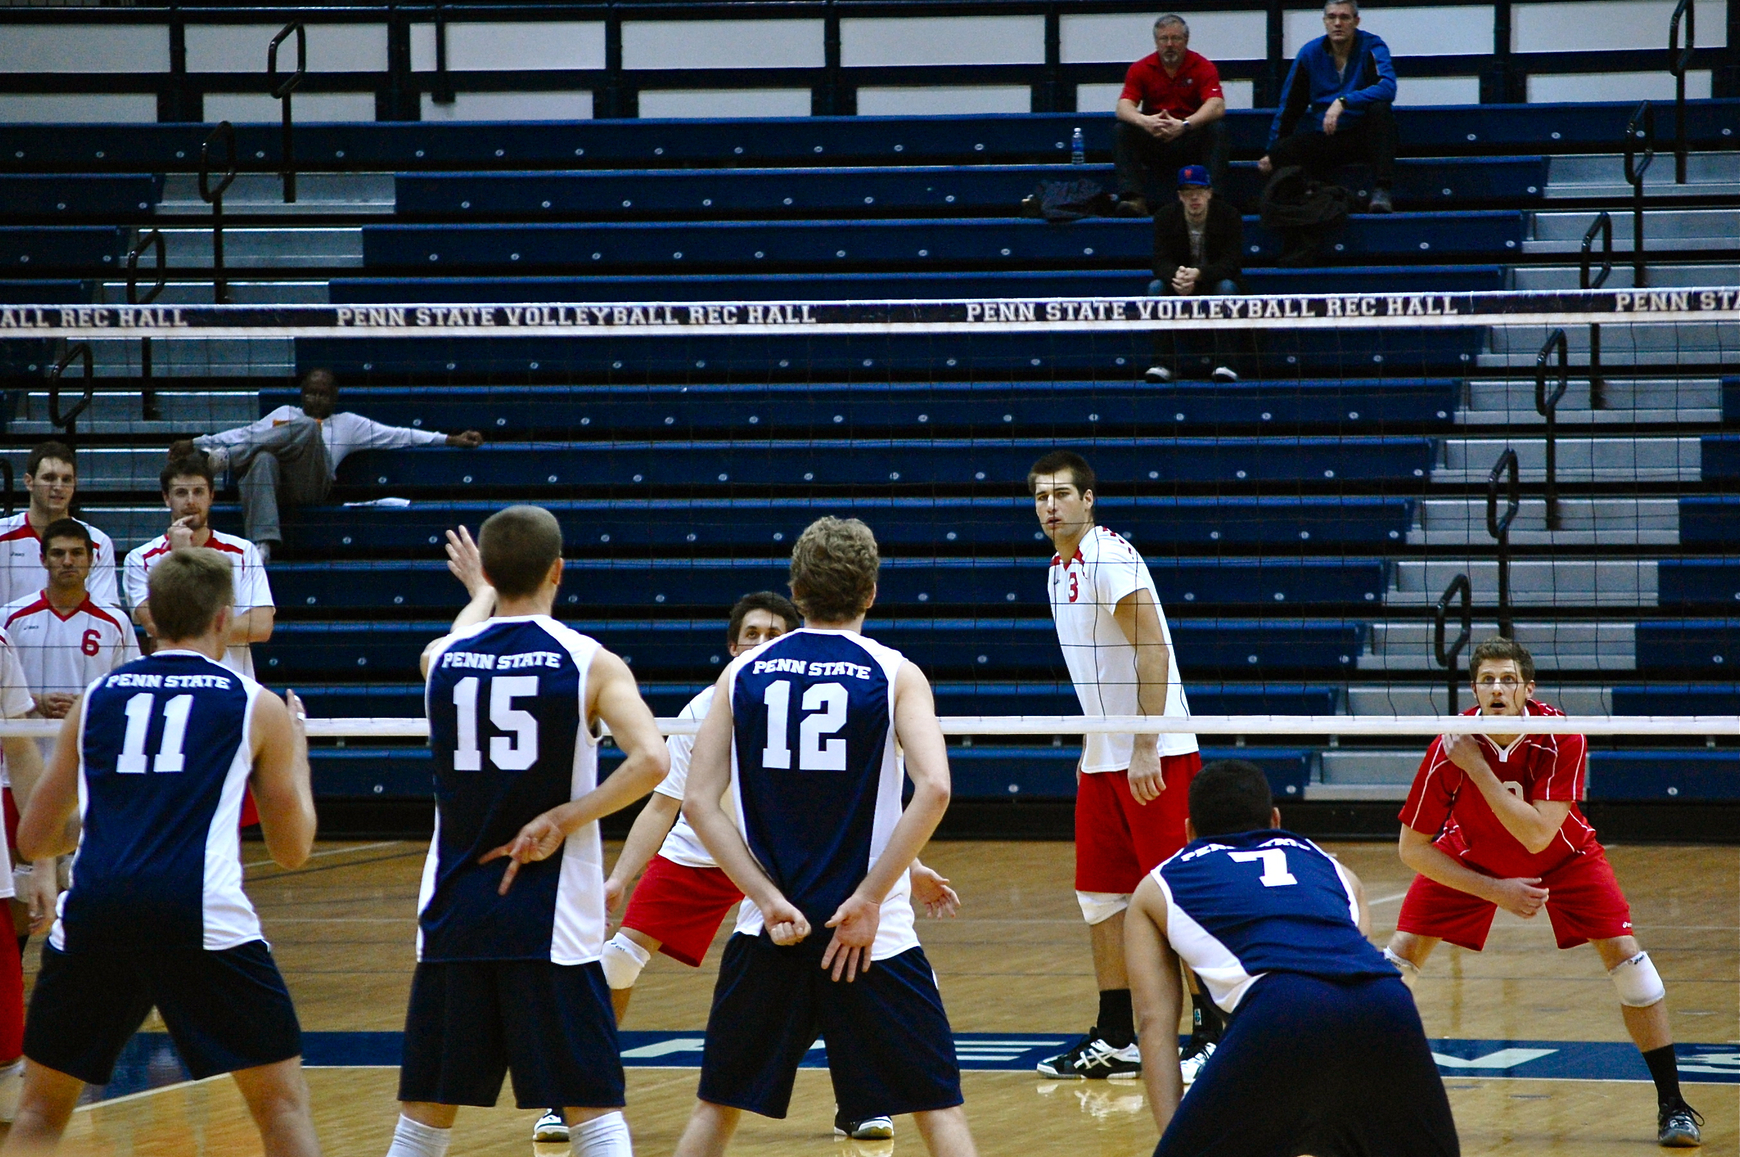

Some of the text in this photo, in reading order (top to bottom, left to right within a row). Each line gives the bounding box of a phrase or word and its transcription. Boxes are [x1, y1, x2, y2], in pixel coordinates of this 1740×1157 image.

[966, 296, 1458, 322] PENN STATE VOLLEYBALL REC HALL
[1614, 291, 1689, 312] PENN
[60, 308, 109, 328] REC
[119, 307, 188, 327] HALL
[336, 304, 817, 327] PENN STATE VOLLEYBALL REC HALL
[1068, 572, 1078, 602] 3
[81, 629, 101, 657] 6
[441, 651, 563, 670] PENN STATE
[752, 658, 872, 680] PENN STATE
[105, 674, 231, 690] PENN STATE
[116, 693, 194, 774] 11
[453, 676, 539, 771] 15
[762, 680, 849, 771] 12
[1227, 848, 1298, 888] 7
